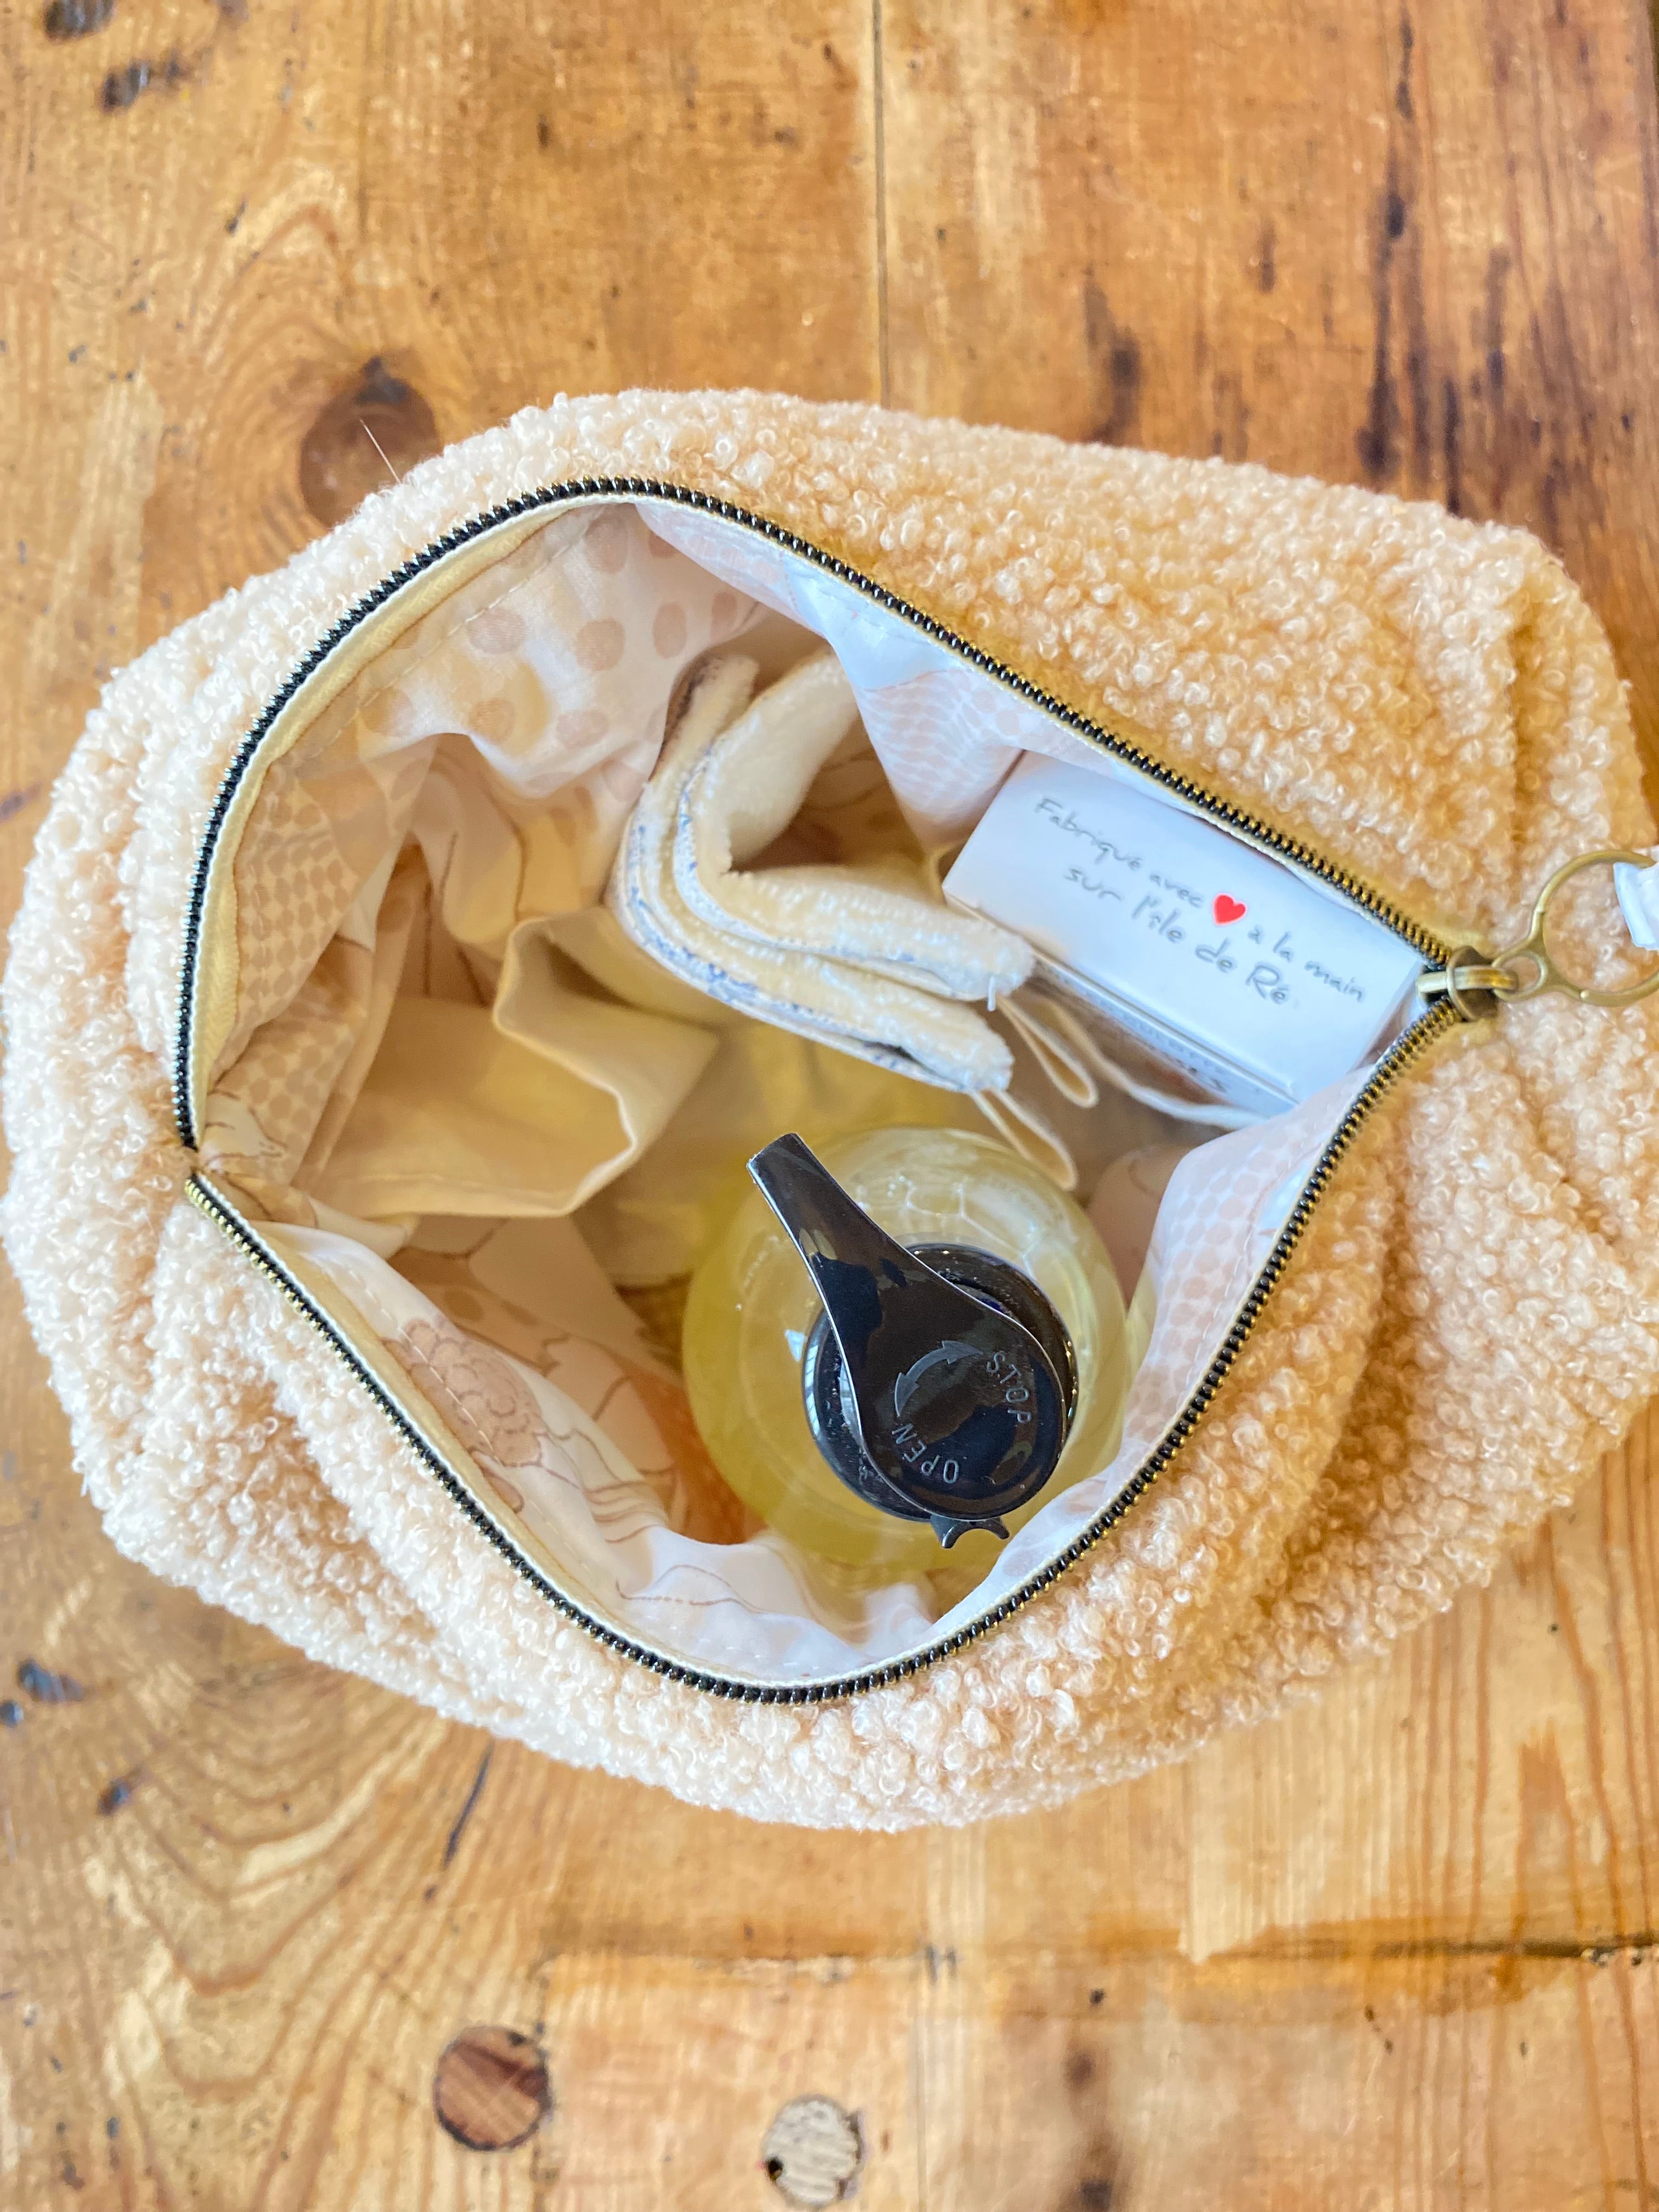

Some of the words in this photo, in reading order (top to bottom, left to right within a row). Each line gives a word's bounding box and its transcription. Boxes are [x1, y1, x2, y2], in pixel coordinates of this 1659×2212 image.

[1036, 798, 1143, 871] Fabriqué
[1149, 874, 1202, 908] avec
[1272, 932, 1293, 964] la
[1304, 960, 1365, 1002] main
[1063, 867, 1123, 901] sur
[1194, 937, 1236, 973] de
[986, 1352, 1032, 1425] STOP
[891, 1424, 960, 1484] OPEN
